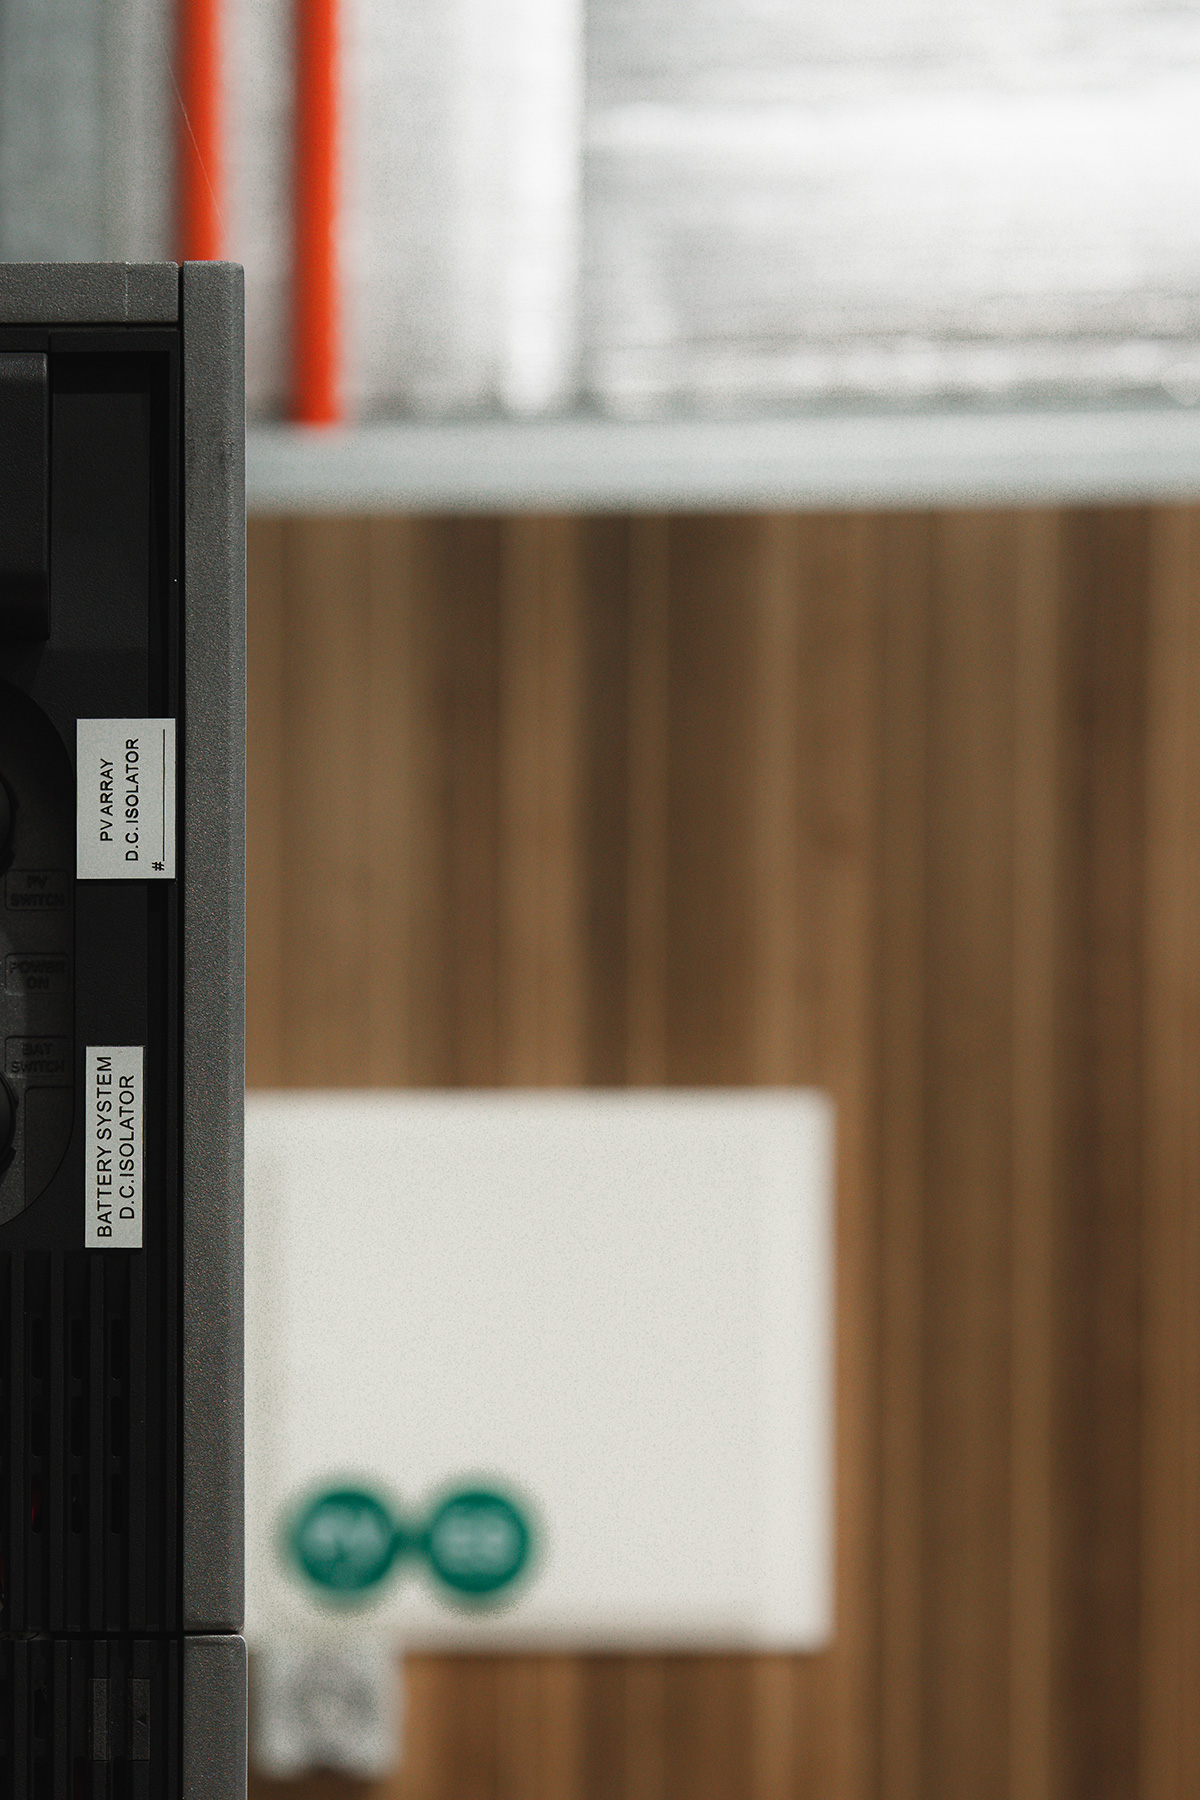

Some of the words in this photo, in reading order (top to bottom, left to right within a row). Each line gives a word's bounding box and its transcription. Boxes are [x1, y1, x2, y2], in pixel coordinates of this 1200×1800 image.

[99, 758, 113, 817] ARRAY
[99, 819, 113, 842] PV
[10, 892, 65, 906] SWITCH
[10, 961, 66, 975] POWER
[26, 976, 50, 990] ON
[22, 1043, 53, 1056] BAT
[10, 1061, 65, 1074] SWITCH
[97, 1057, 112, 1141] SYSTEM
[97, 1145, 112, 1238] BATTERY
